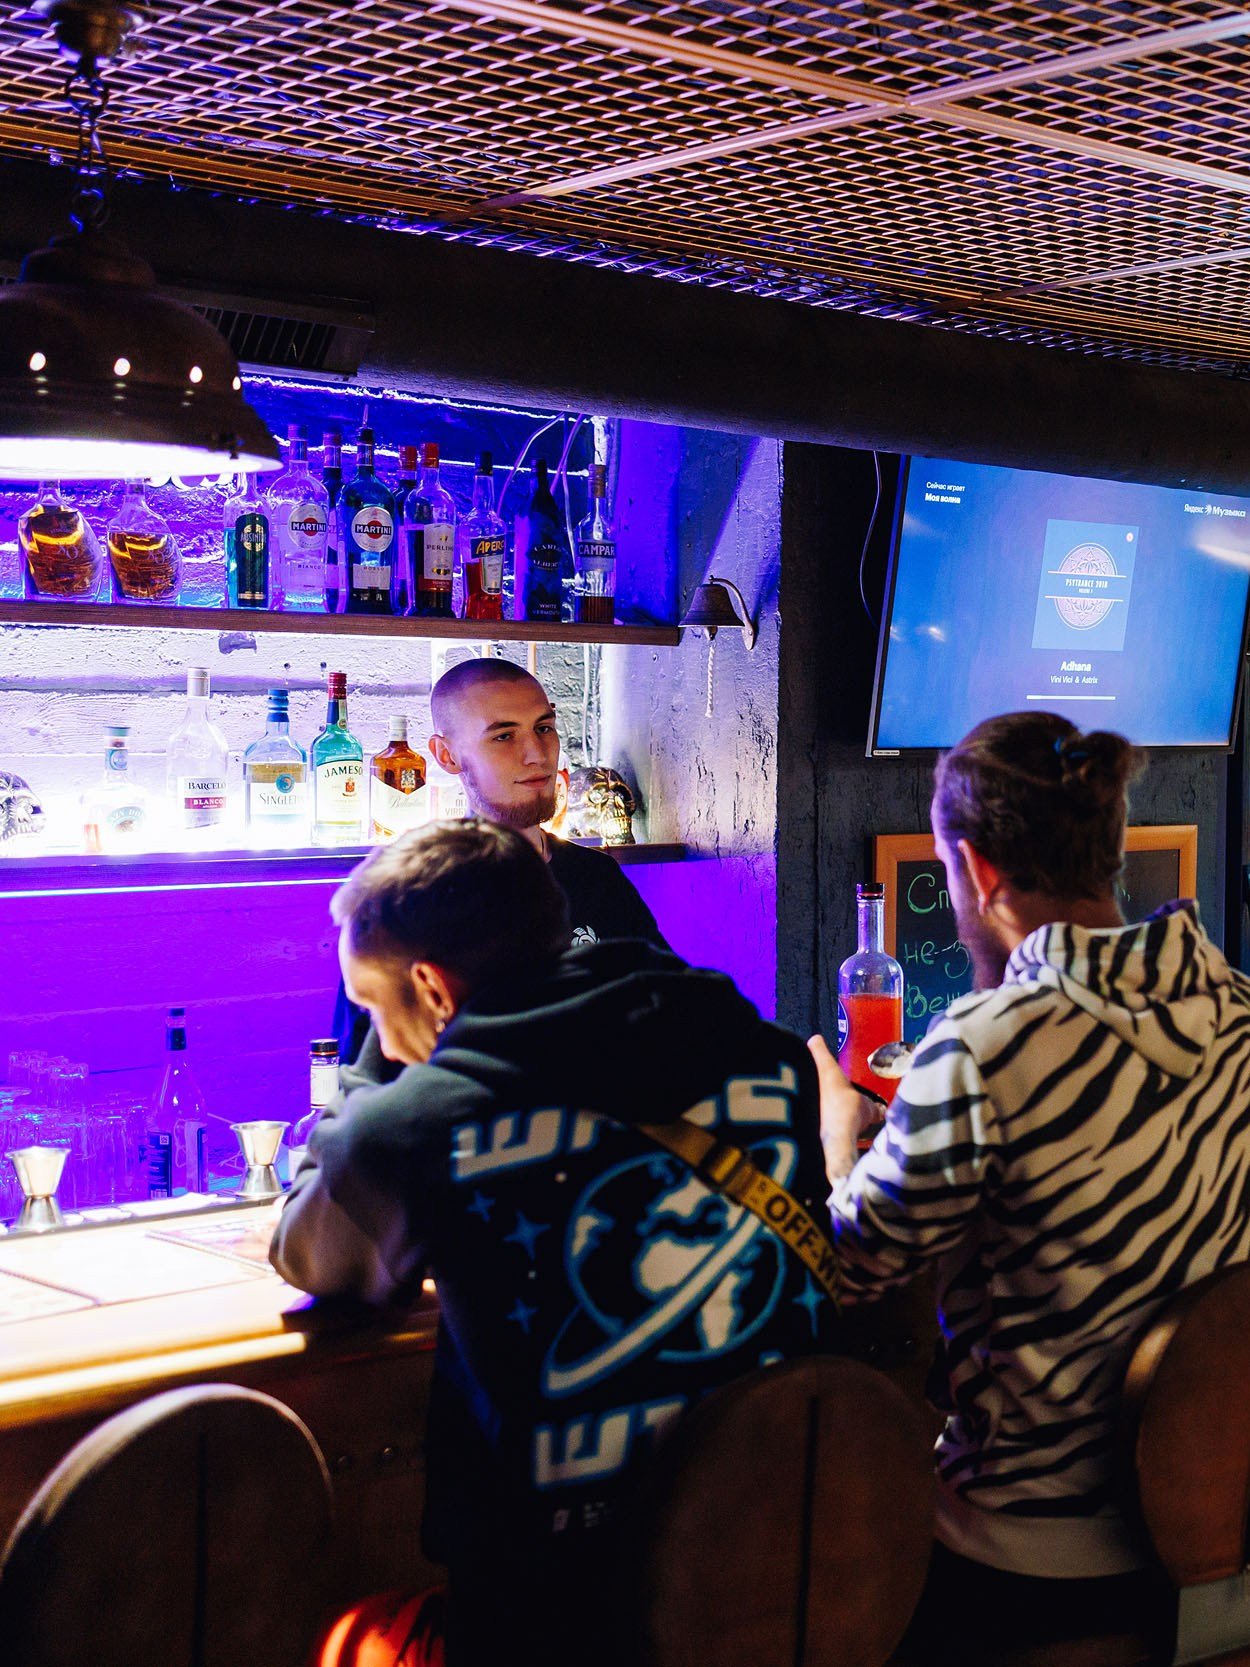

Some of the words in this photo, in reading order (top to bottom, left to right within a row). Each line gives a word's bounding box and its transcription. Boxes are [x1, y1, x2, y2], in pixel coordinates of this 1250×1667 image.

[926, 481, 946, 490] Сейчас
[947, 484, 966, 493] играет
[925, 492, 940, 502] Моя
[940, 495, 961, 504] волна
[1183, 503, 1204, 514] Яндекс
[1212, 506, 1246, 518] Музыка
[292, 522, 326, 532] MARTINI
[356, 524, 391, 535] MARTINI
[1065, 578, 1094, 588] PSYTRANCE
[1060, 660, 1092, 672] Adhana
[1050, 675, 1062, 683] Vini
